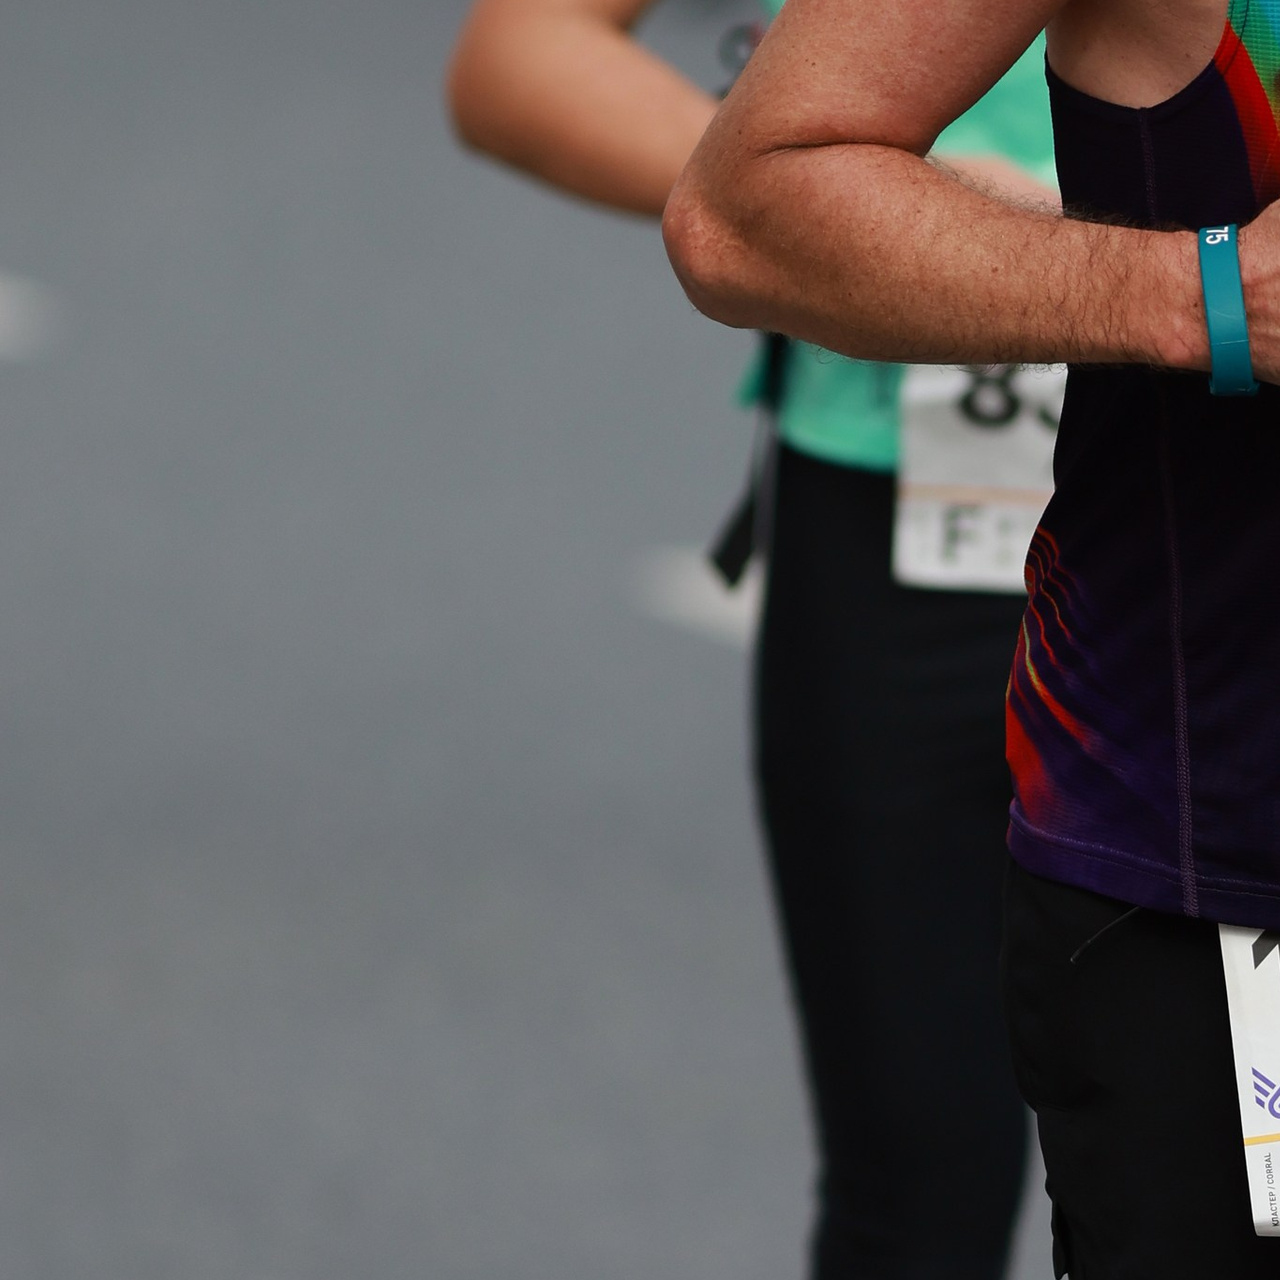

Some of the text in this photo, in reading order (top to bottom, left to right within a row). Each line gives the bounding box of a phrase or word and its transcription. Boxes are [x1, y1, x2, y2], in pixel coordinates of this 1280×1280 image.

[960, 363, 1060, 433] 8
[1263, 1152, 1275, 1185] CORRAL
[1268, 1191, 1280, 1227] КЛАСТЕР
